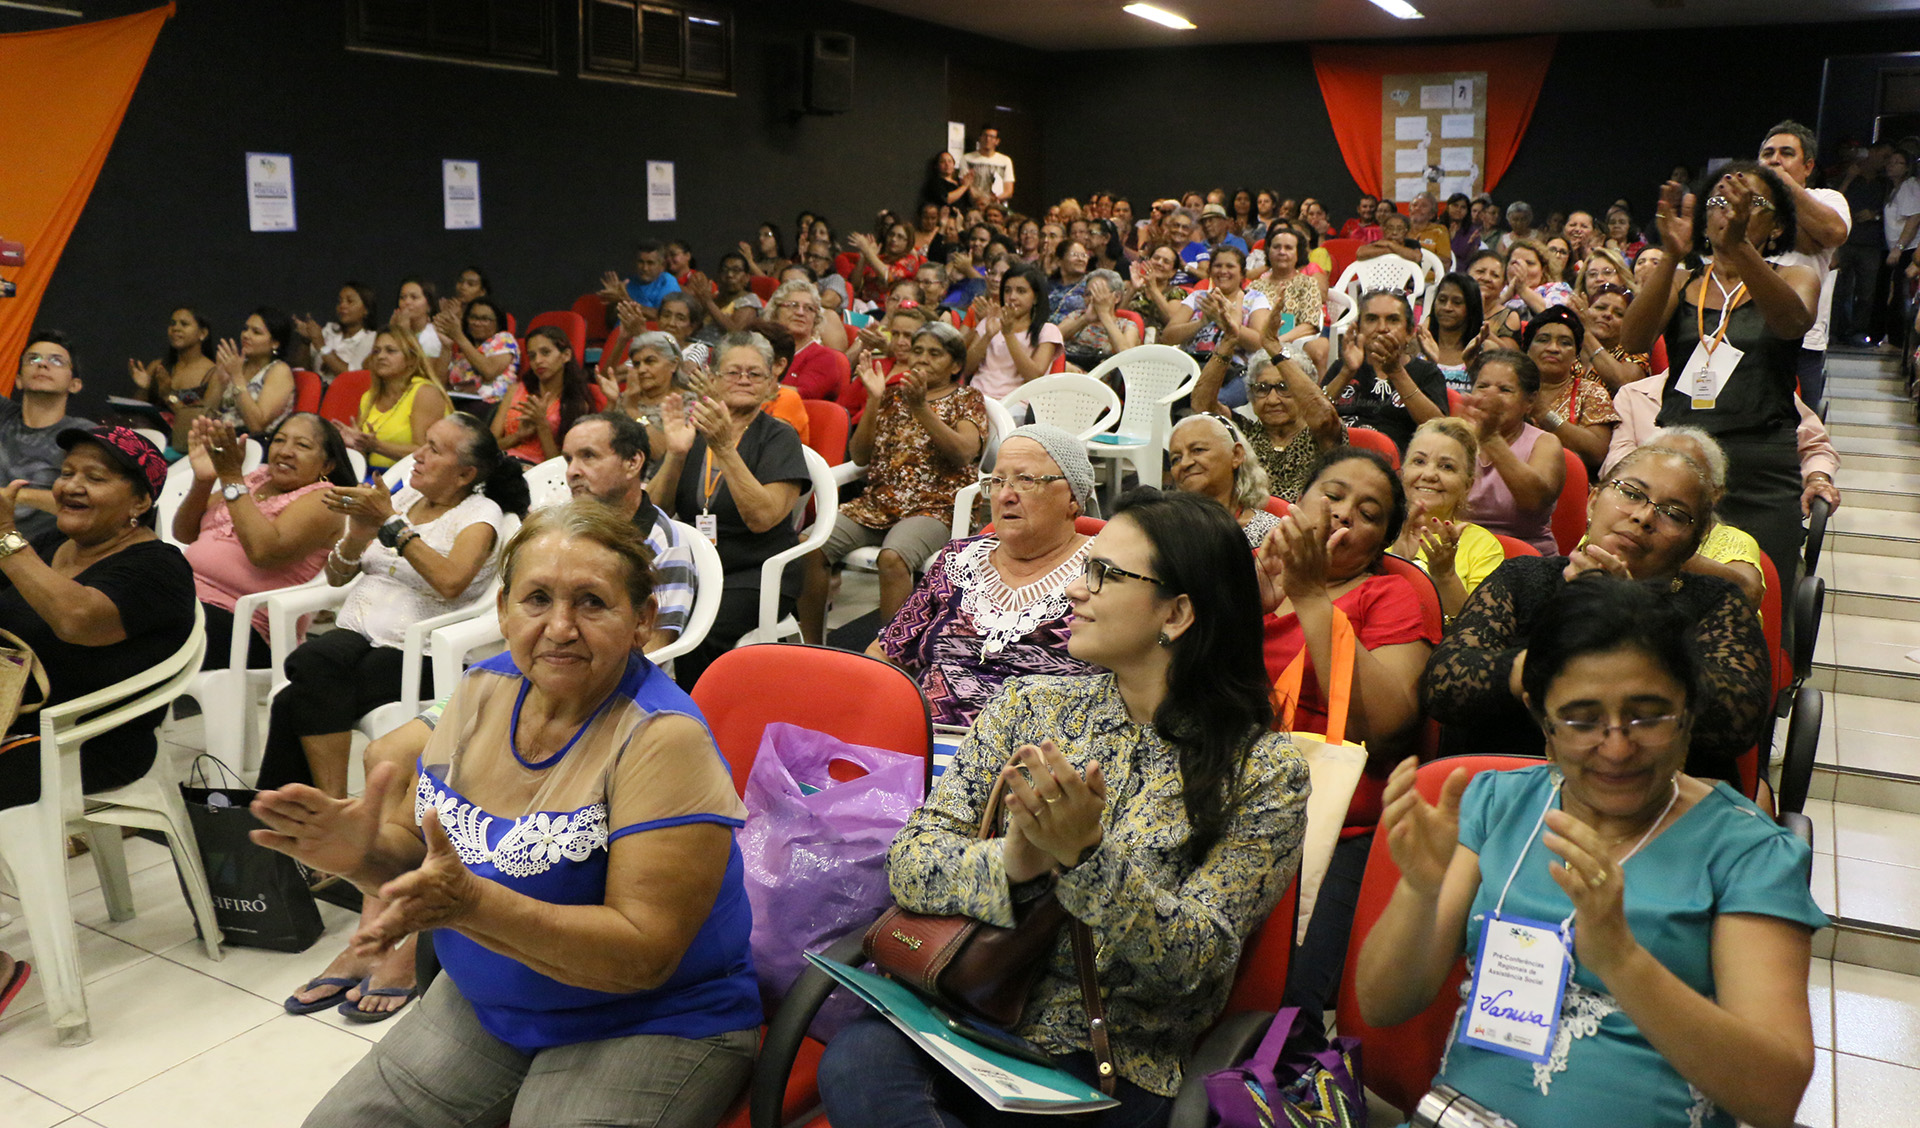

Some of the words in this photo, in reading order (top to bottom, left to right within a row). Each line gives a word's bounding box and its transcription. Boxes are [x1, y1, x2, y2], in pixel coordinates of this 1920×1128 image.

[1497, 962, 1528, 974] Regionais
[1488, 968, 1523, 981] Assistência
[1524, 975, 1543, 985] Social
